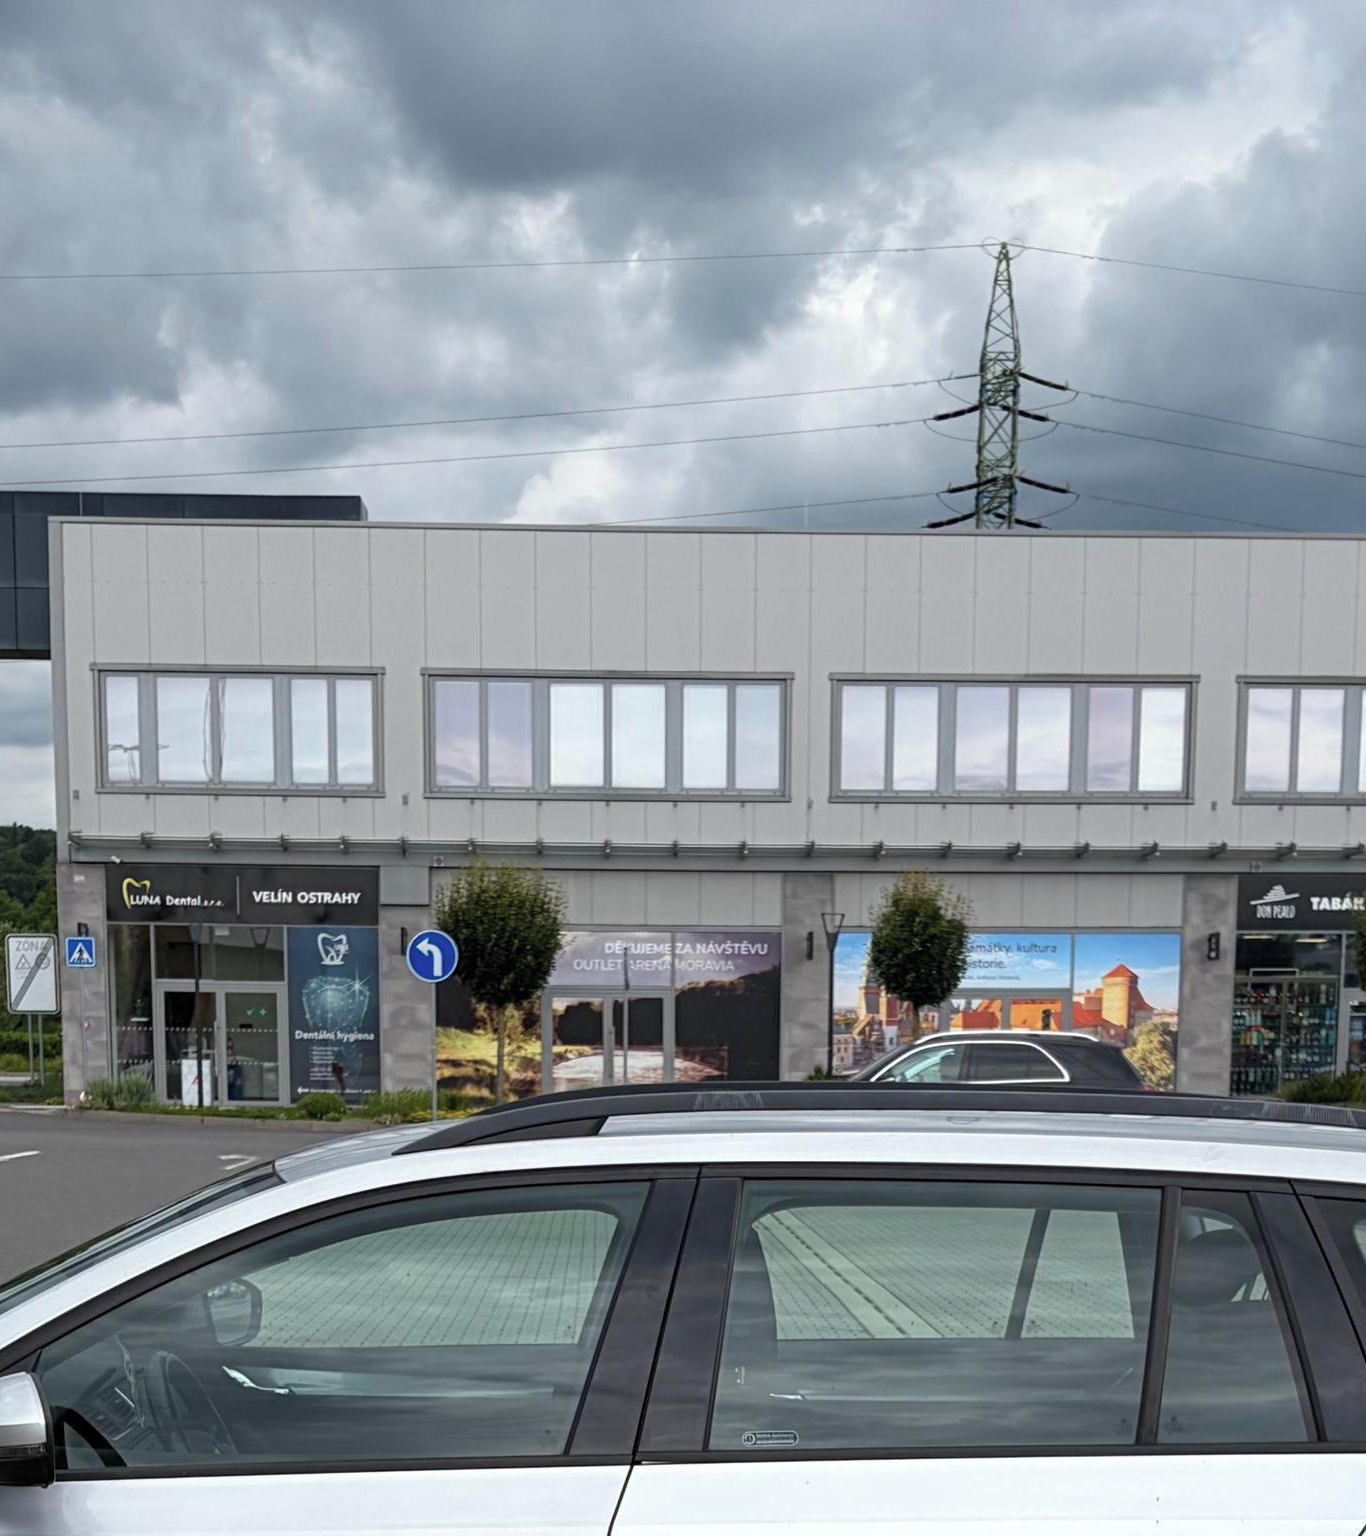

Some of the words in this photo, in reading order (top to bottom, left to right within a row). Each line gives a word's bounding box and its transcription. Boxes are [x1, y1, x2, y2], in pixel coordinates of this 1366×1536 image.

[130, 894, 161, 905] LUNA
[165, 895, 201, 906] Dental
[252, 888, 293, 904] VELÍN
[296, 891, 361, 904] OSTRAHY
[1310, 891, 1365, 911] TABÁK
[675, 943, 693, 954] ZA
[695, 940, 769, 955] NÁVŠTĚVU
[1016, 942, 1058, 953] kultura
[573, 959, 623, 971] OUTLET
[336, 1030, 375, 1043] hygiena
